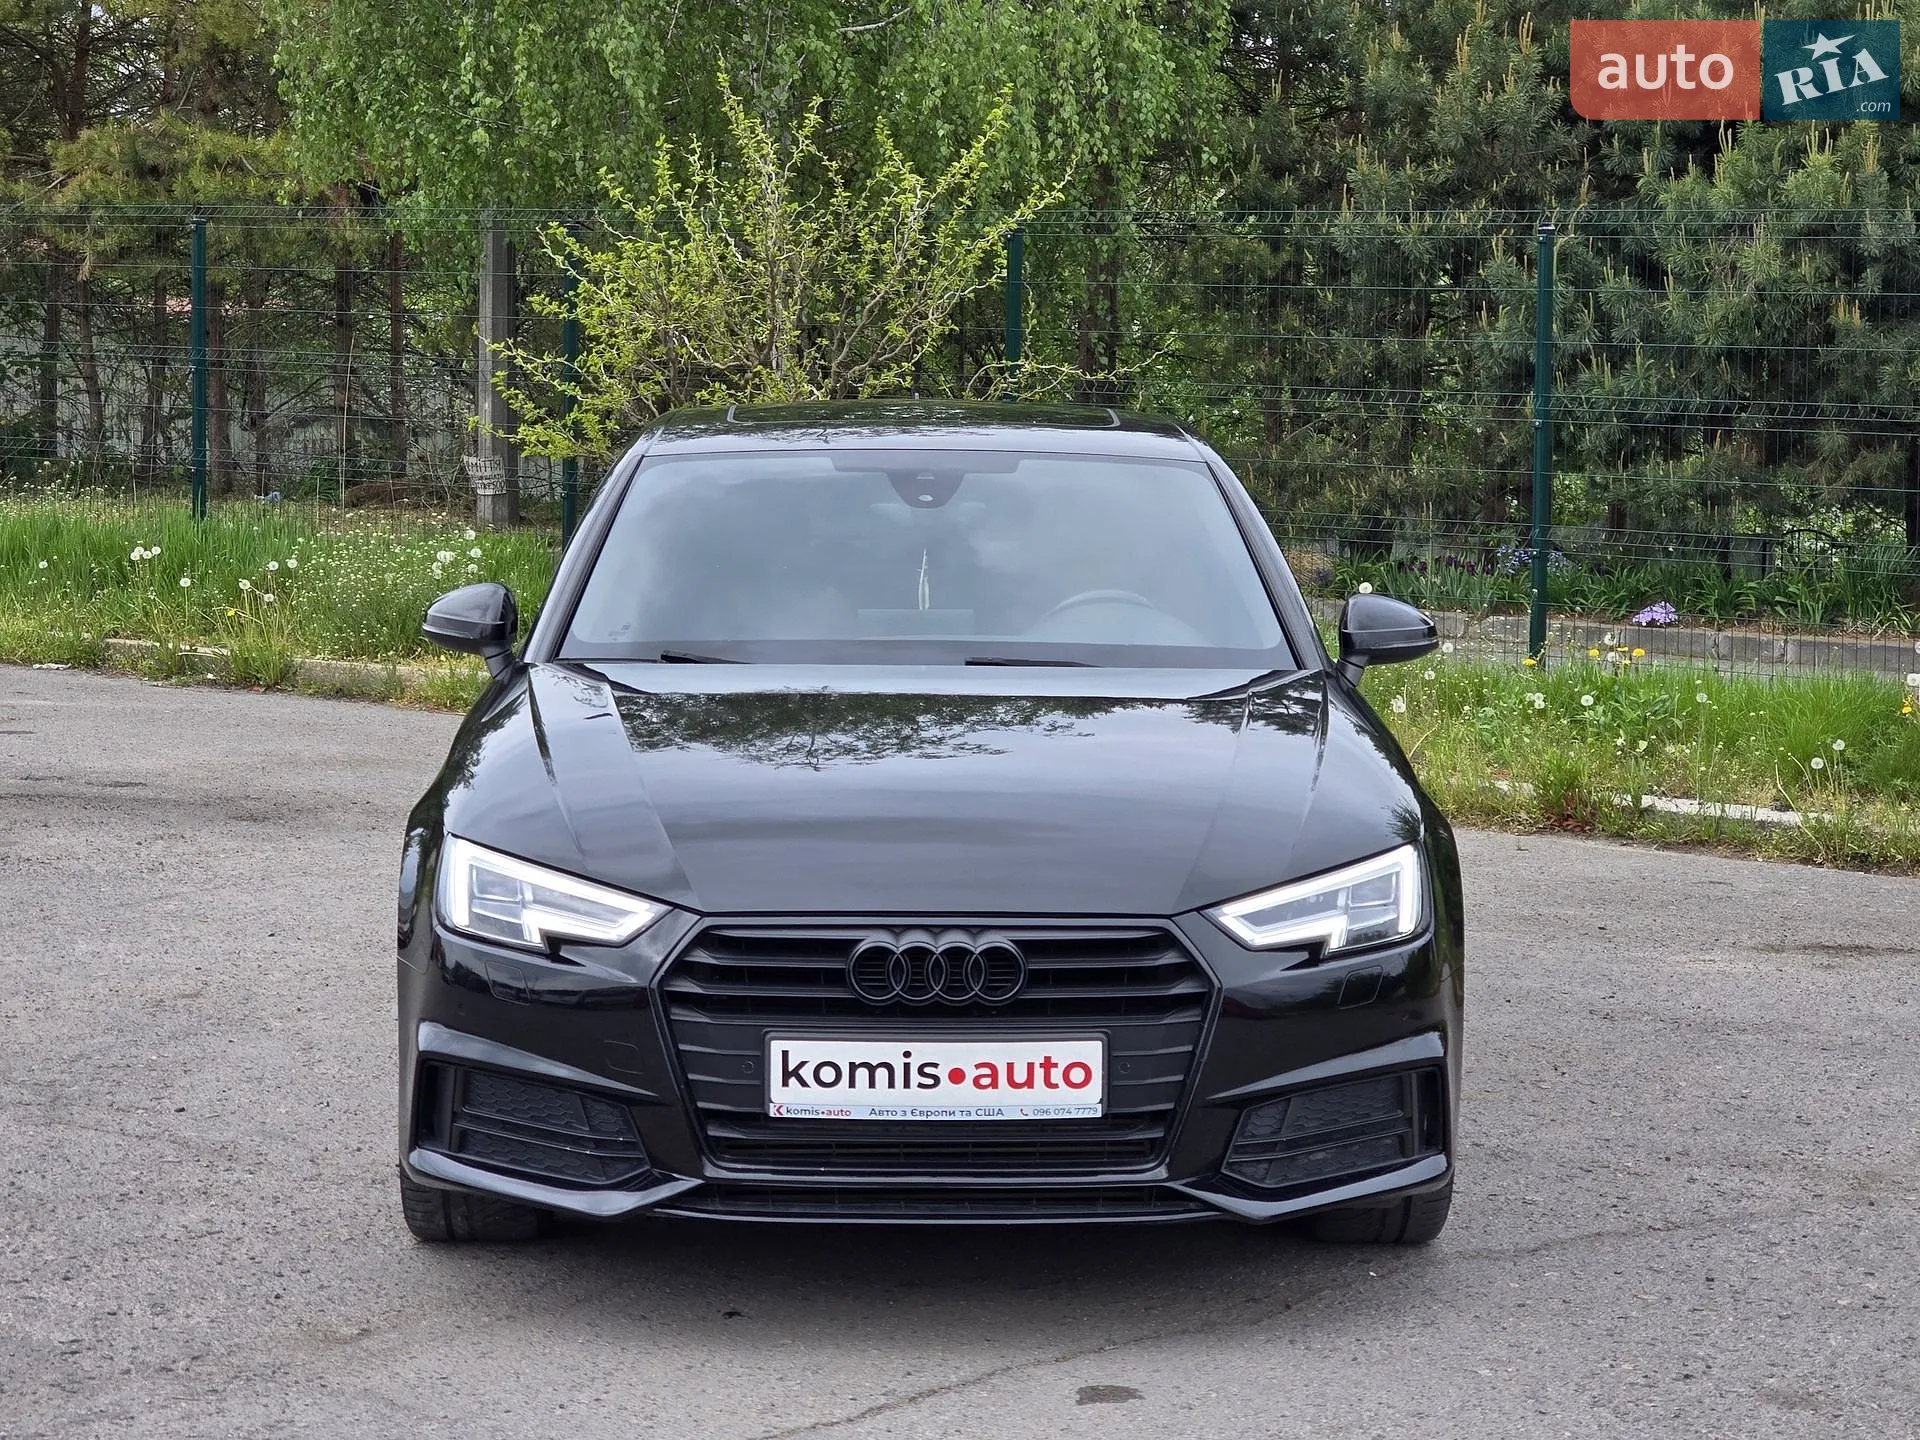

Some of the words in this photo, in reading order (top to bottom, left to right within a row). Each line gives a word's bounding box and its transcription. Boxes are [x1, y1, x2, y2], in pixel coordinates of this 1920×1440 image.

[869, 1108, 898, 1117] Авто
[910, 1108, 956, 1119] Європи
[959, 1109, 972, 1117] та
[975, 1108, 1005, 1117] США
[1032, 1108, 1052, 1117] 096
[1054, 1107, 1072, 1116] 074
